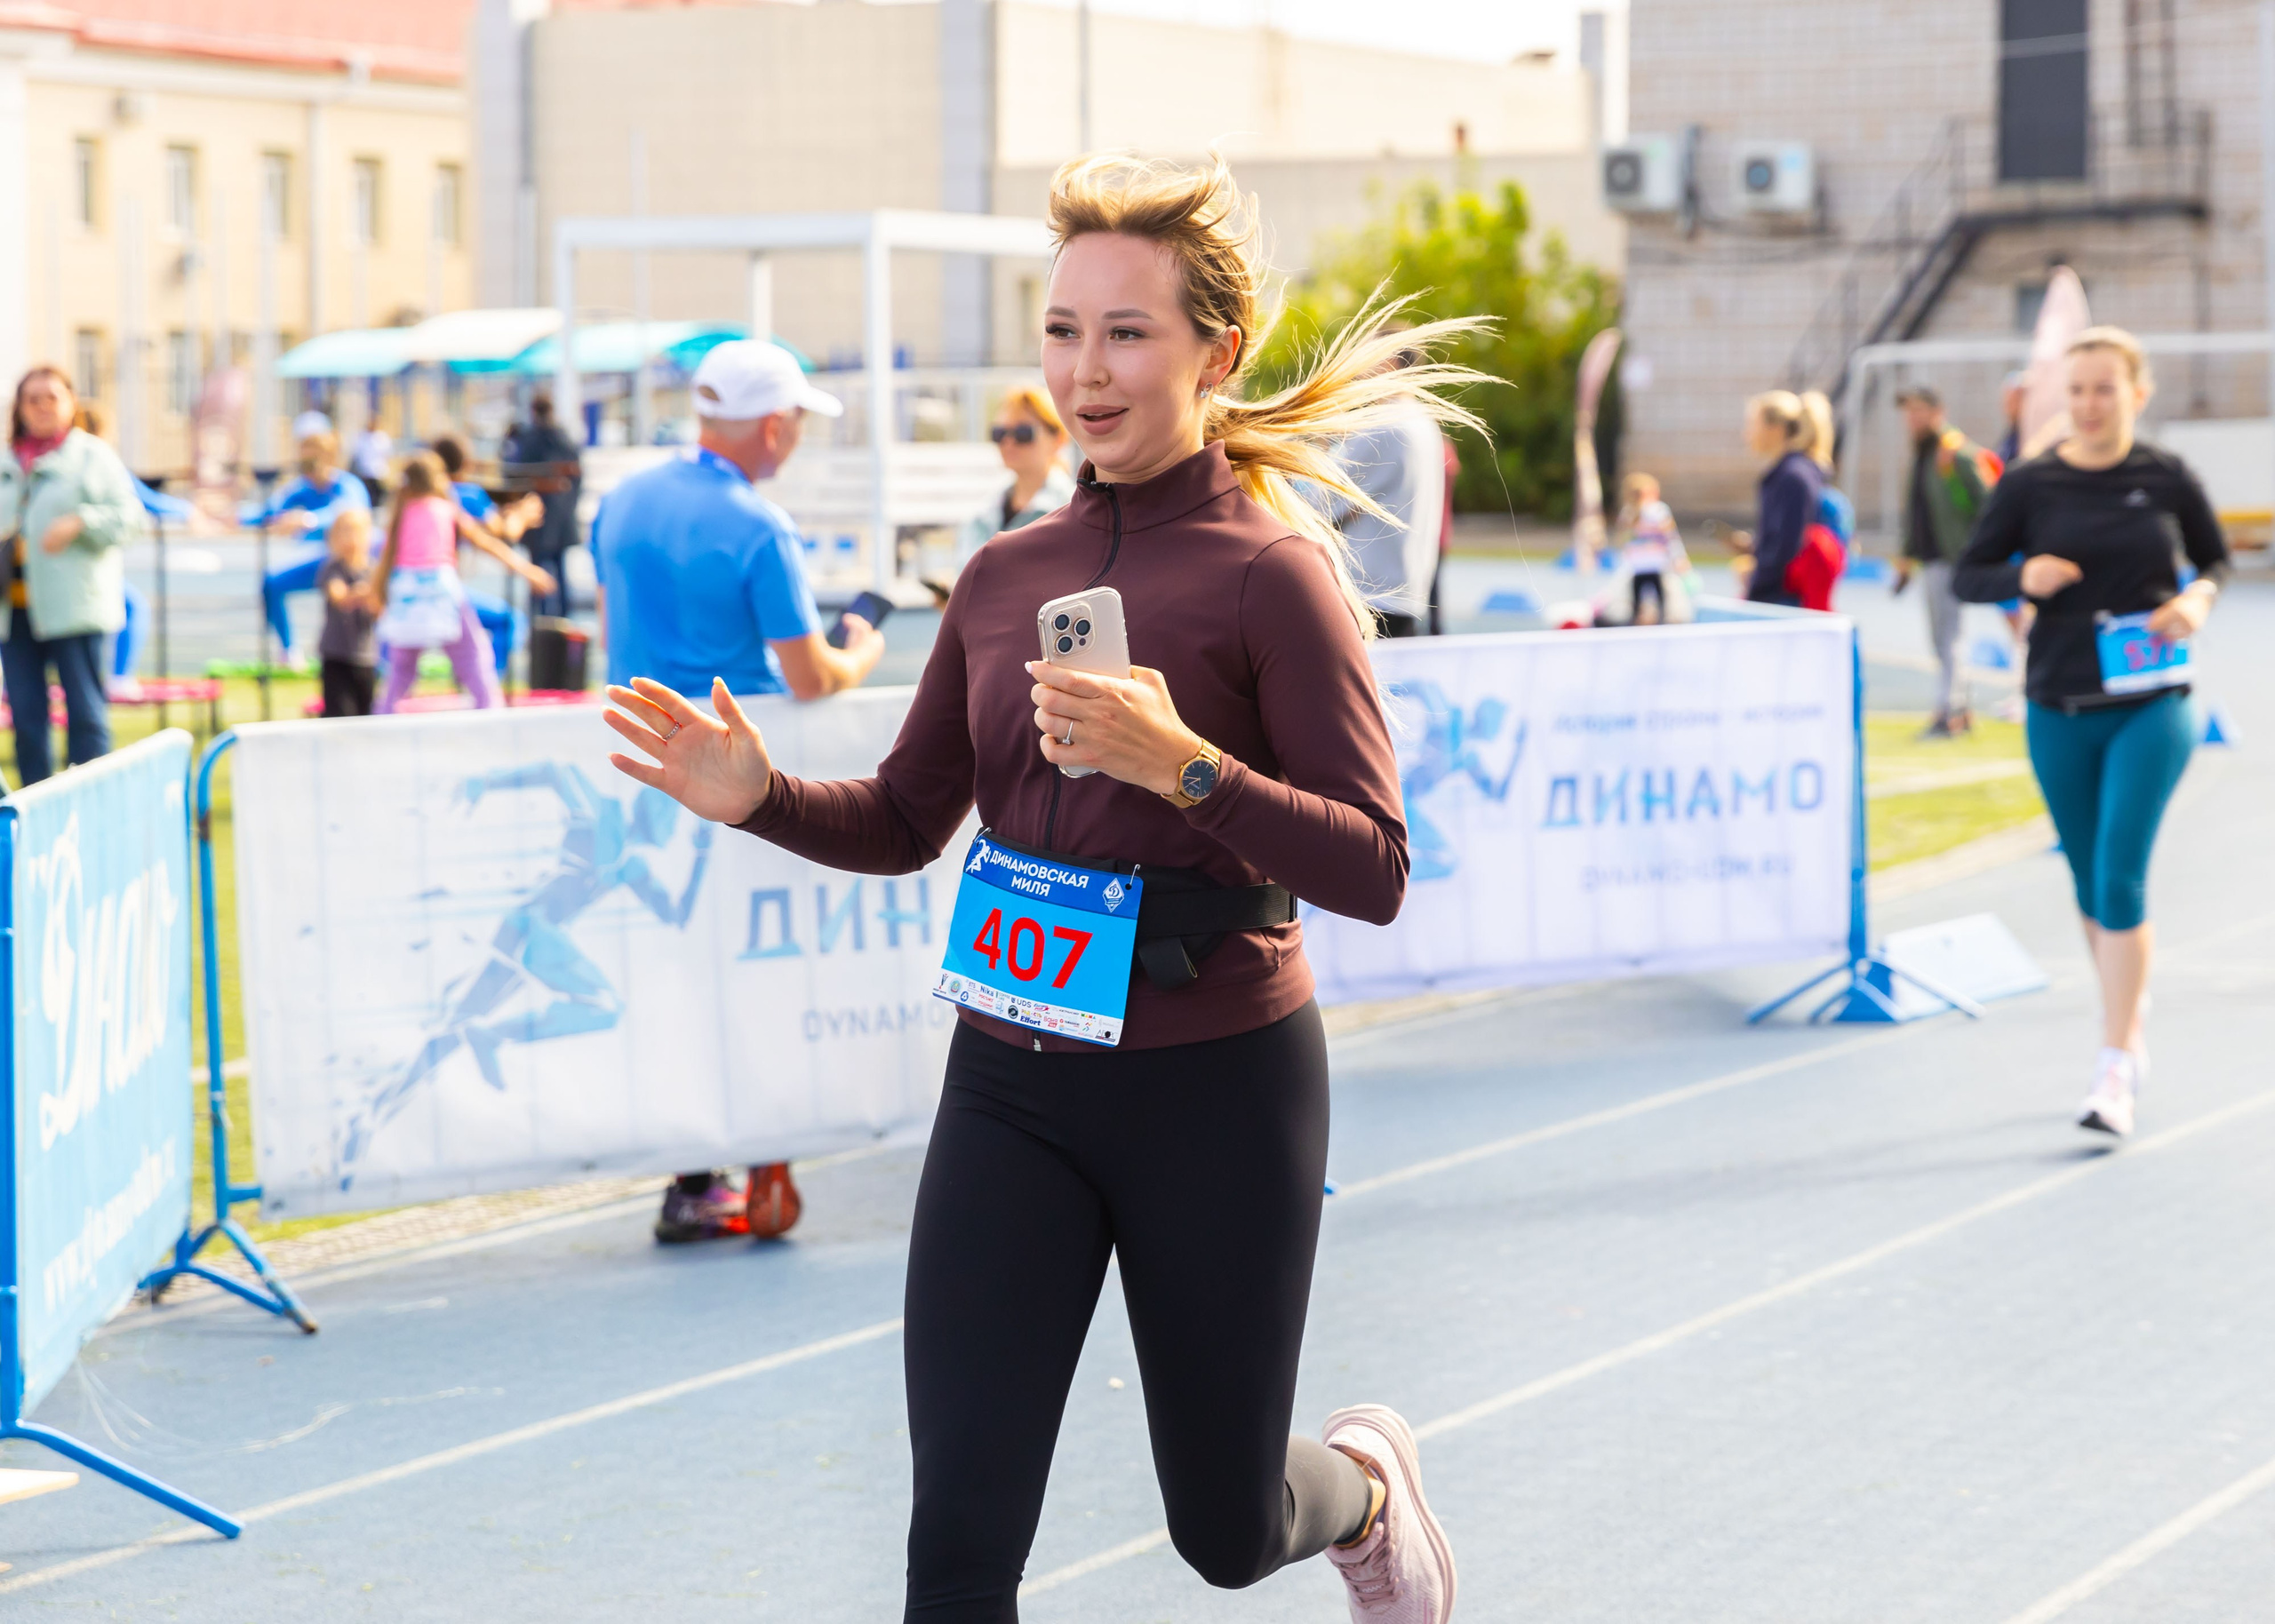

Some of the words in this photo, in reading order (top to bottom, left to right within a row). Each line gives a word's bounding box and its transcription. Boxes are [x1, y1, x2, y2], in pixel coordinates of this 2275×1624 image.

[1540, 760, 1824, 829] ДИНАМО
[989, 849, 1090, 888] ДИНАМОВСКАЯ
[1010, 875, 1051, 897] МИЛЯ
[736, 876, 951, 960] ДИН
[973, 907, 1094, 990] 407
[980, 984, 994, 997] Nika
[1017, 998, 1032, 1008] UDS
[802, 999, 956, 1043] DYNAMO
[1020, 1015, 1041, 1026] Effort
